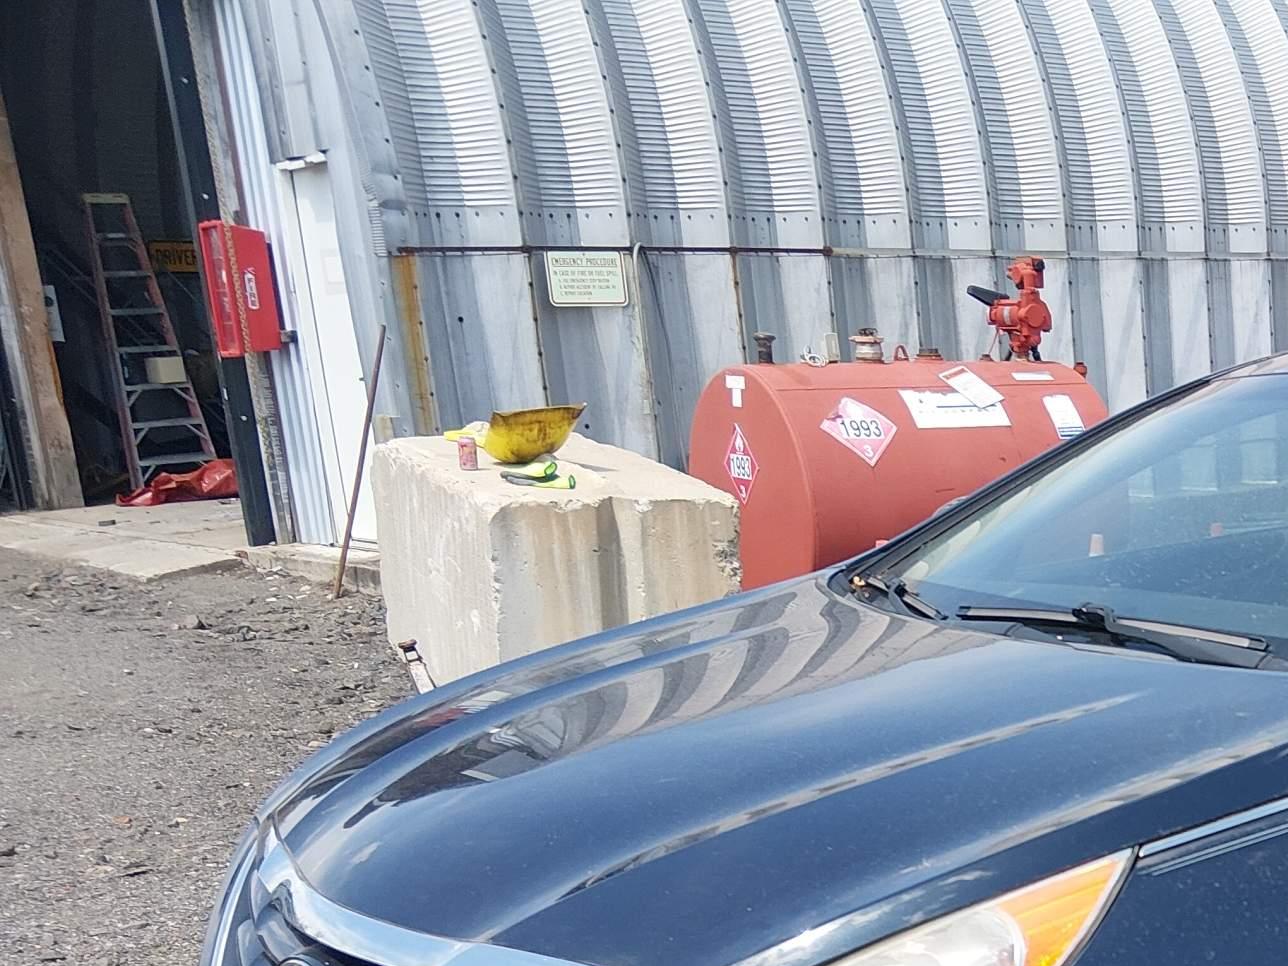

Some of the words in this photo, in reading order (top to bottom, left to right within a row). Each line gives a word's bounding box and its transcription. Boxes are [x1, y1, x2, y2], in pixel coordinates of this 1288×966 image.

[840, 419, 883, 438] 1993
[862, 444, 875, 458] 3
[731, 456, 751, 478] 1993
[739, 485, 747, 498] 3
